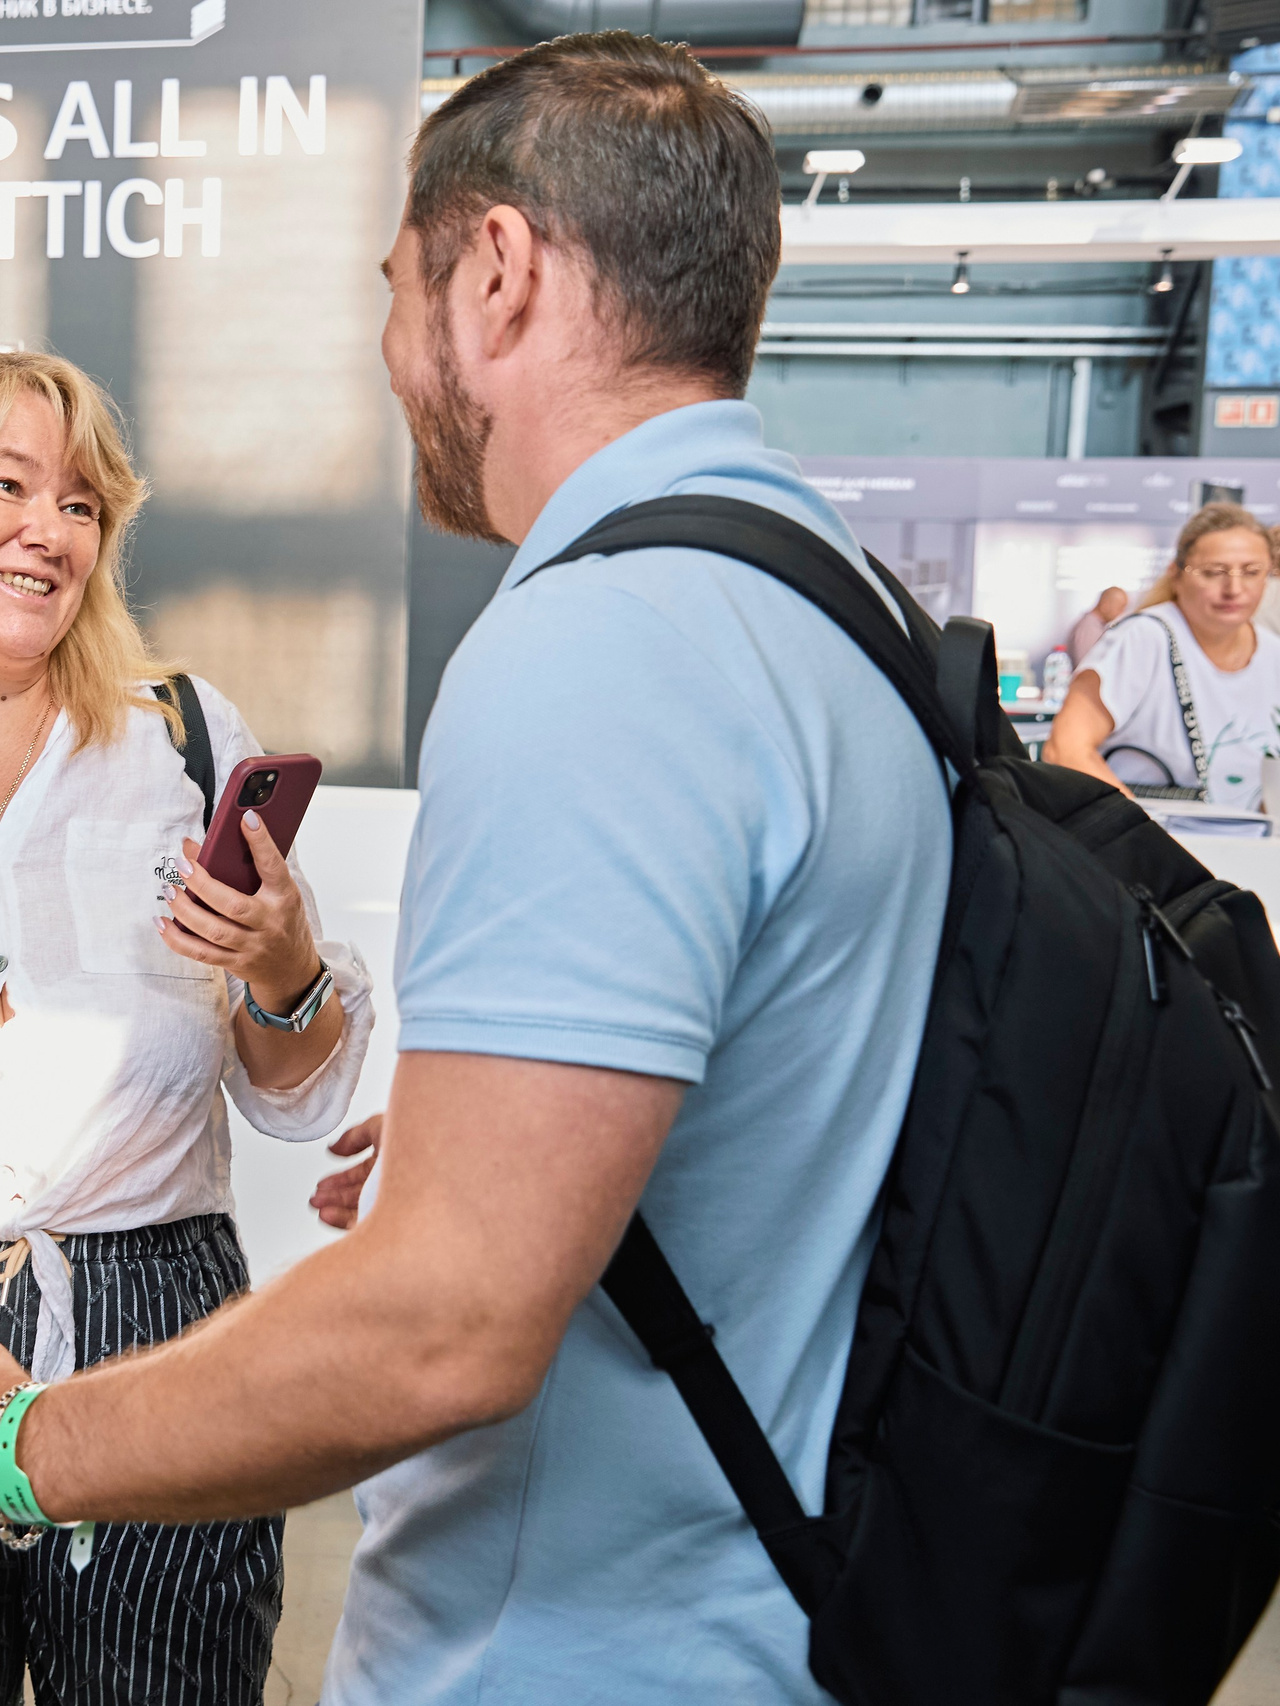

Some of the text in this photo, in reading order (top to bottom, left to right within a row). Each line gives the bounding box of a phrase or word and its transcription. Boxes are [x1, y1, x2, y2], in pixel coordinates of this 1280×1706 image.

[42, 0, 57, 17] В
[44, 78, 208, 160] ALL
[238, 75, 327, 156] IN
